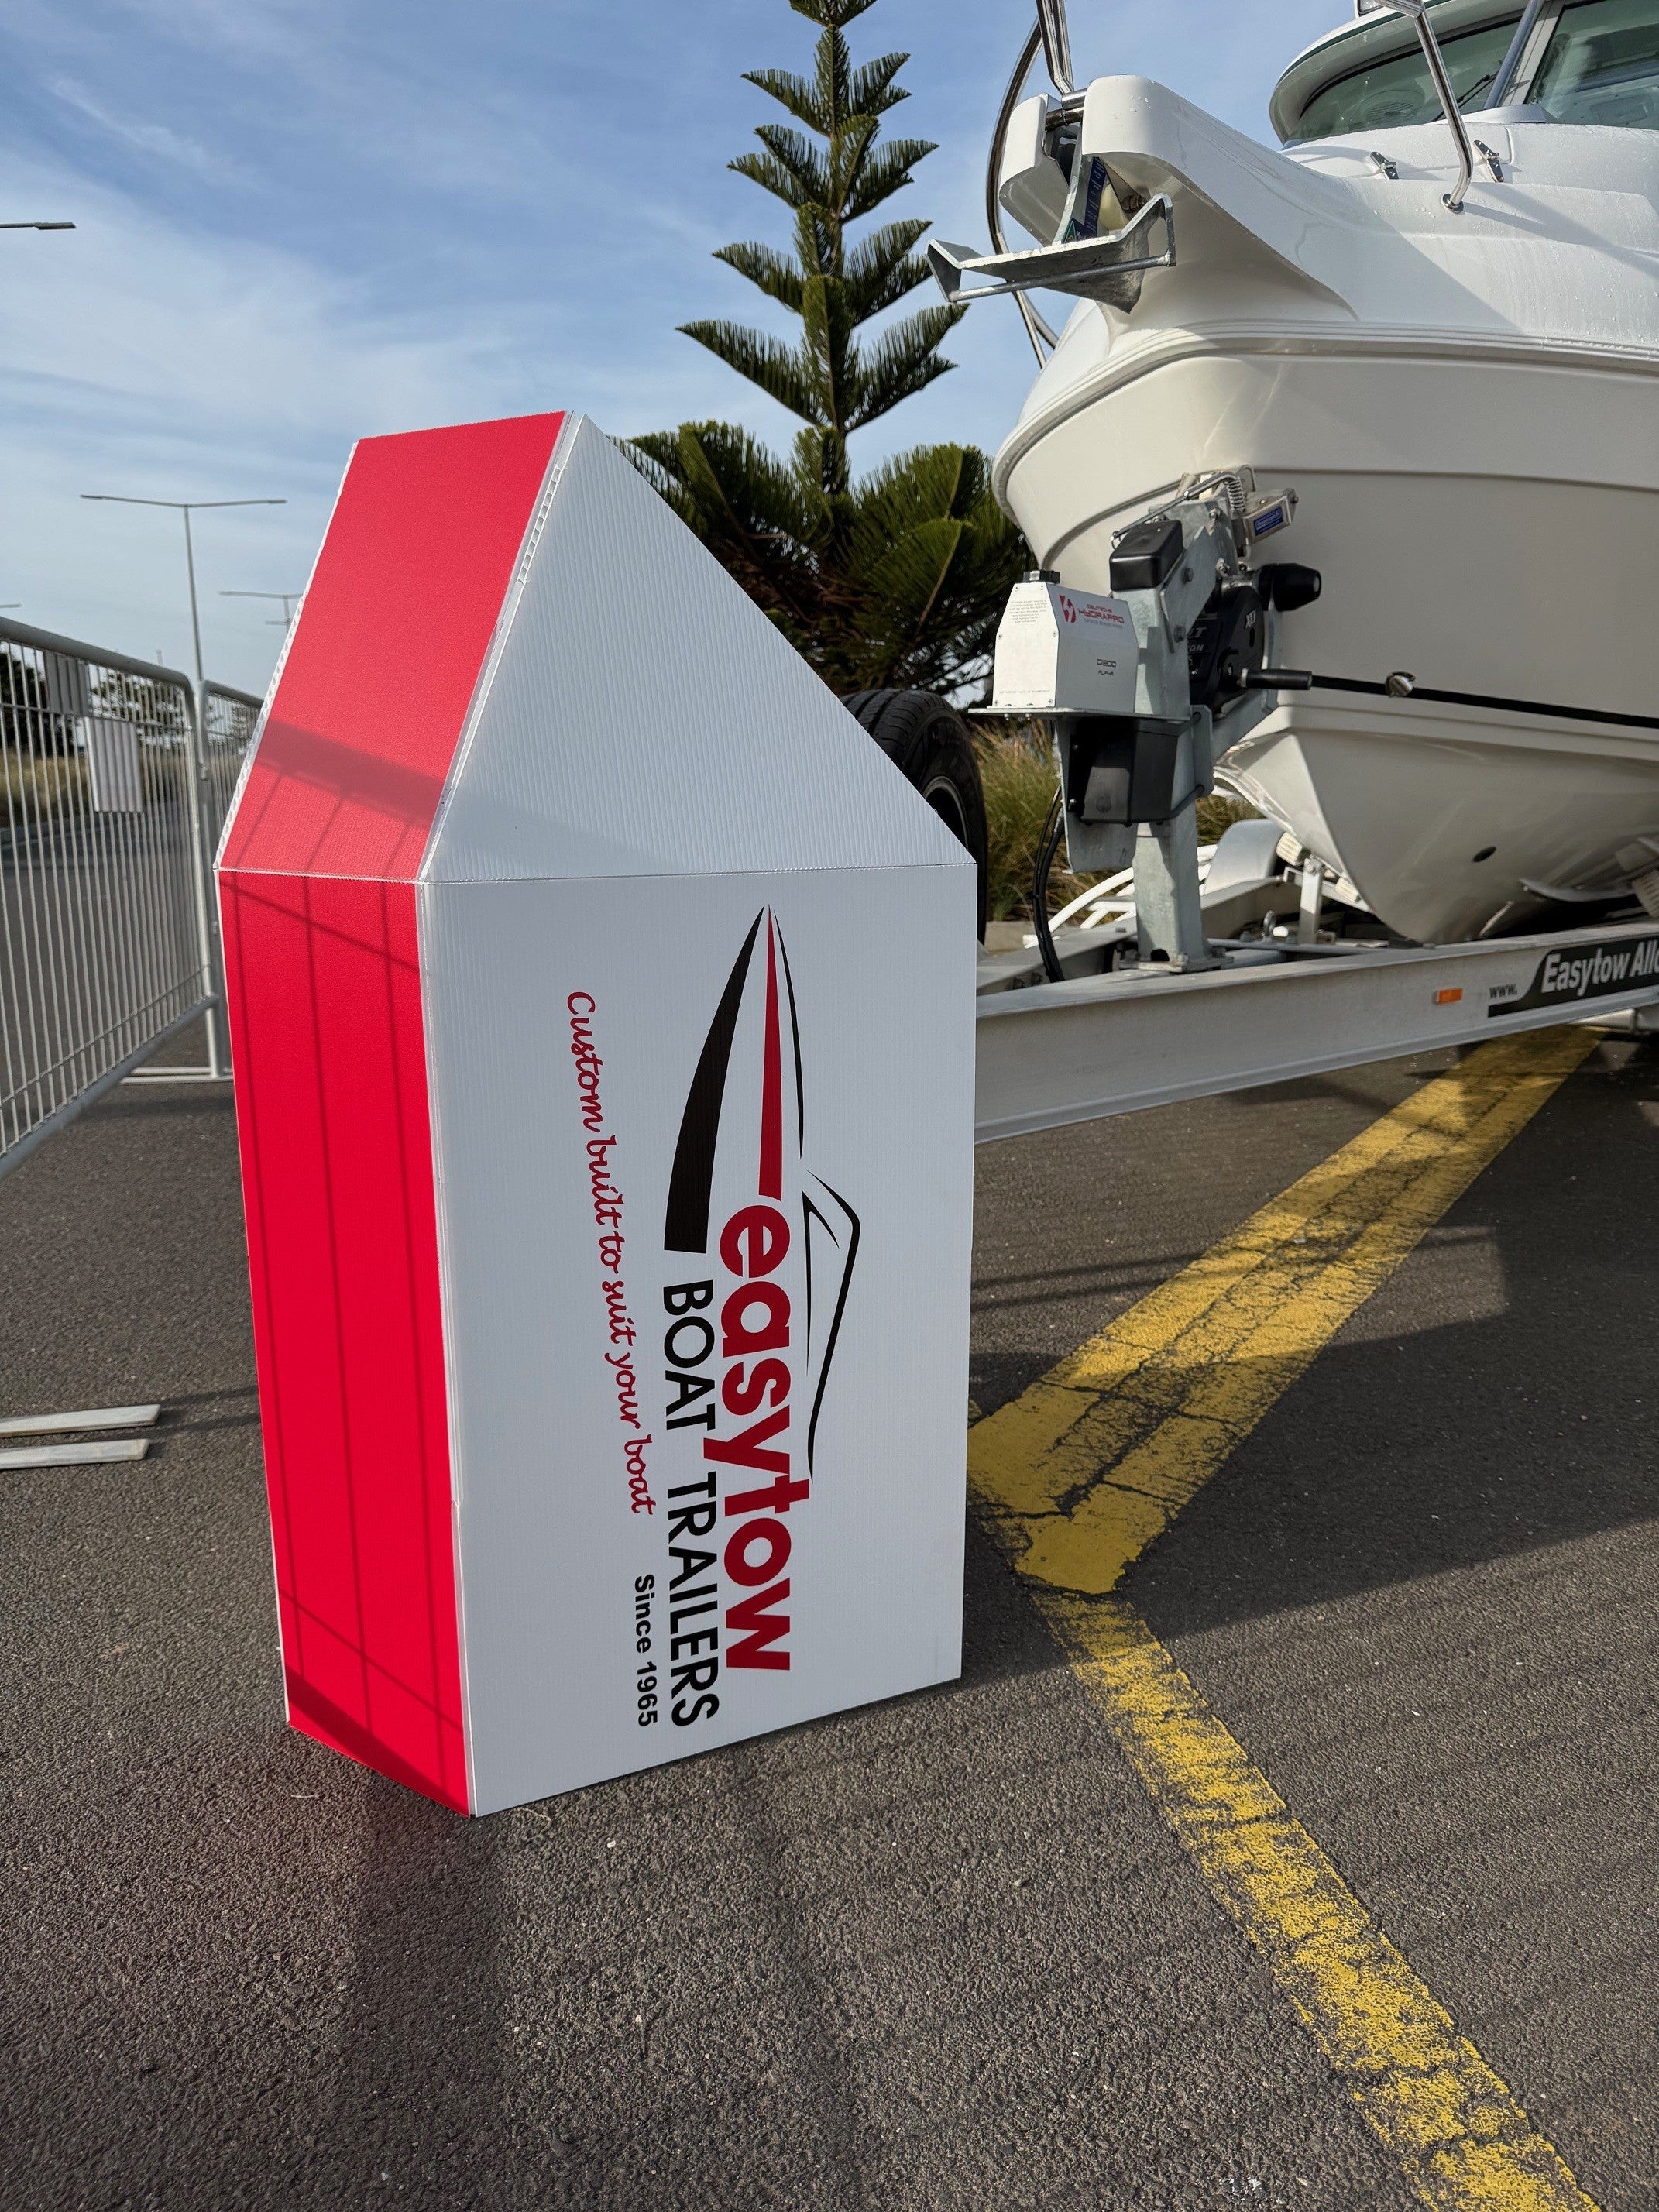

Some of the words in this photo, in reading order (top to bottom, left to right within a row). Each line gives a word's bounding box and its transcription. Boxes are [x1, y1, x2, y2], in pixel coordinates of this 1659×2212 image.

[1541, 948, 1630, 997] Easytow
[567, 991, 603, 1133] Custom
[586, 1135, 624, 1228] built
[599, 1231, 625, 1274] to
[602, 1280, 637, 1346] suit
[604, 1352, 641, 1430] your
[663, 1279, 716, 1431] BOAT
[623, 1434, 656, 1515] boat
[702, 1204, 810, 1671] easytow
[634, 1574, 655, 1654] Since
[667, 1471, 720, 1727] TRAILERS
[637, 1661, 658, 1727] 1965
